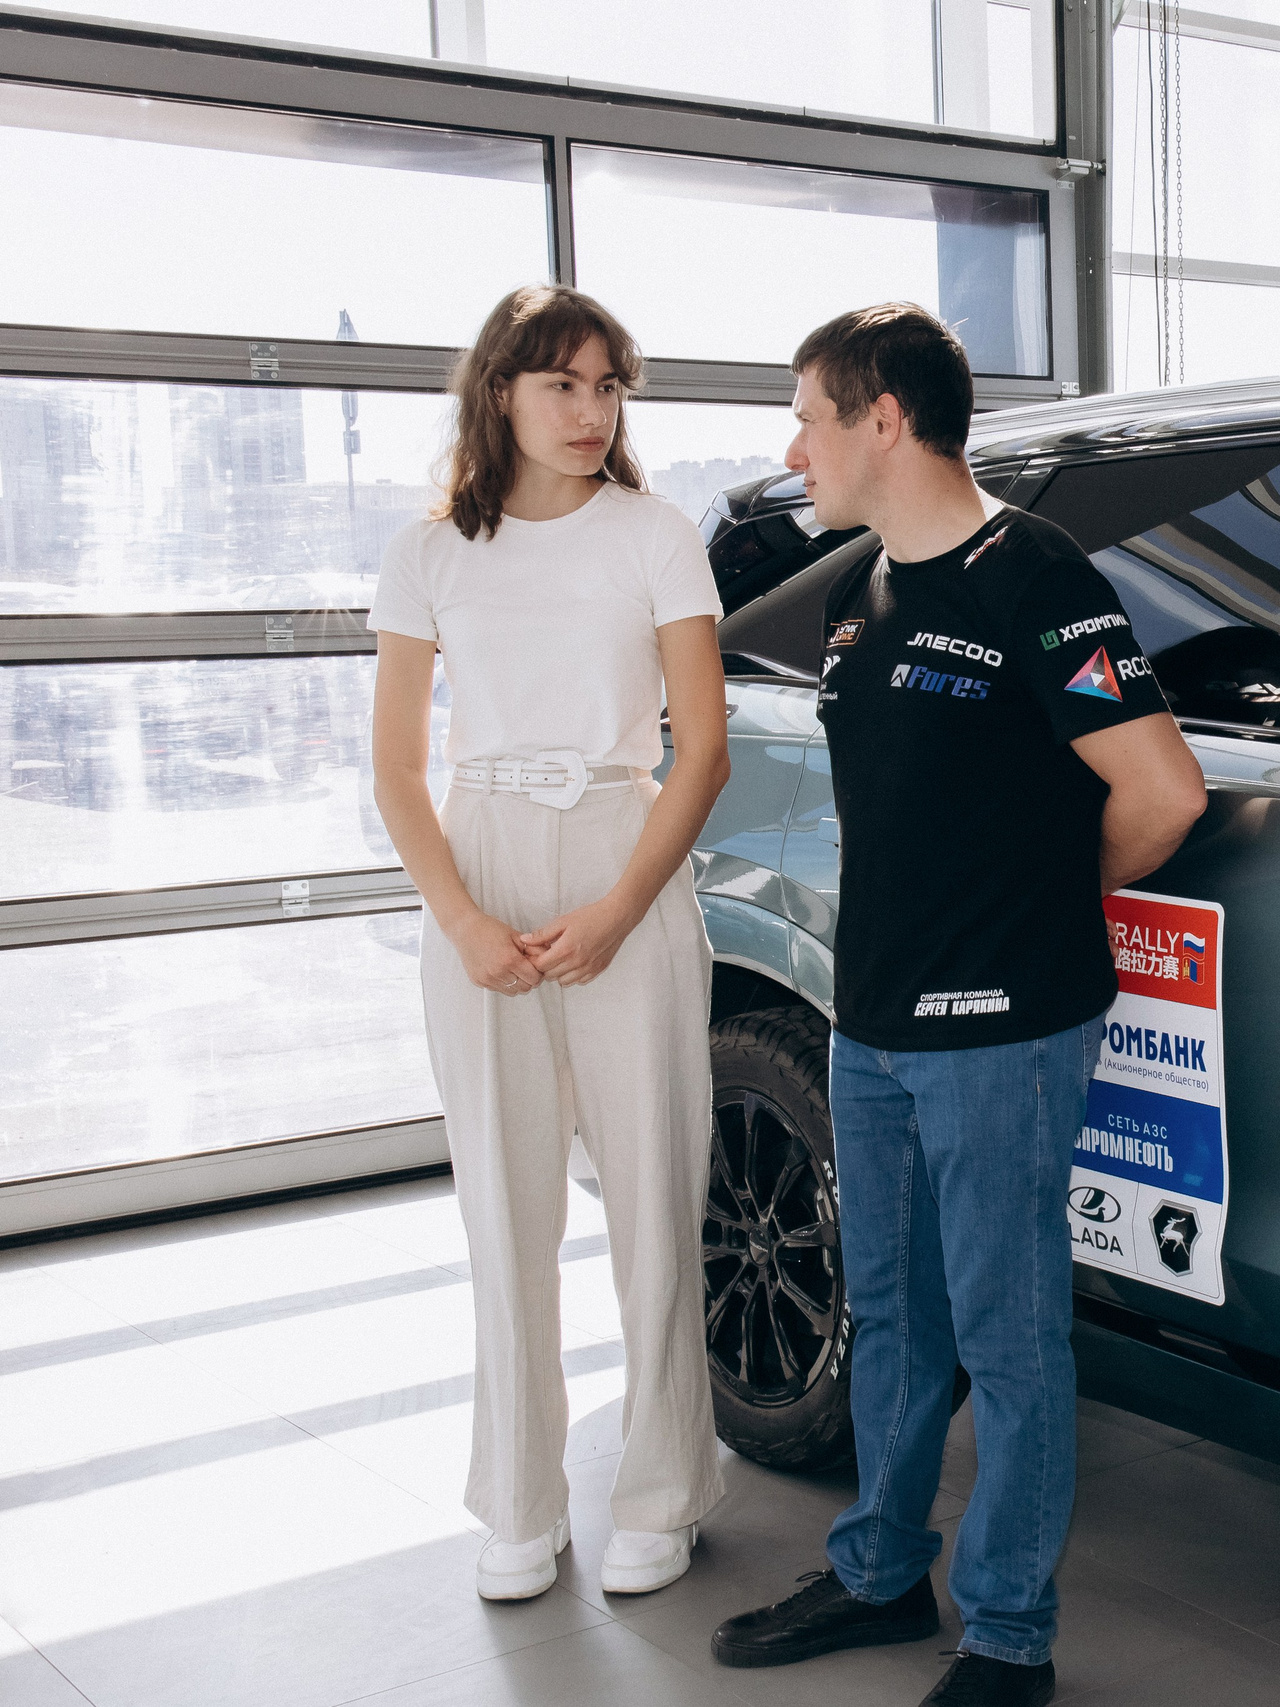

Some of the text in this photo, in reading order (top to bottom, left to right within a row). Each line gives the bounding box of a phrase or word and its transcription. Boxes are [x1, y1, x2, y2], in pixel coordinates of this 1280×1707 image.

[1059, 614, 1130, 642] ХРОМПИК
[907, 632, 1003, 667] JAECOO
[1115, 922, 1180, 954] RALLY
[914, 996, 1010, 1017] СЕРГЕЯ КАРЯКИНА
[920, 988, 1004, 1002] СПОРТИВНАЯ КОМАНДА
[1104, 1057, 1210, 1093] (Акционерное общество)
[1108, 1113, 1168, 1140] СЕТЬ АЗС
[1068, 1222, 1124, 1257] LADA
